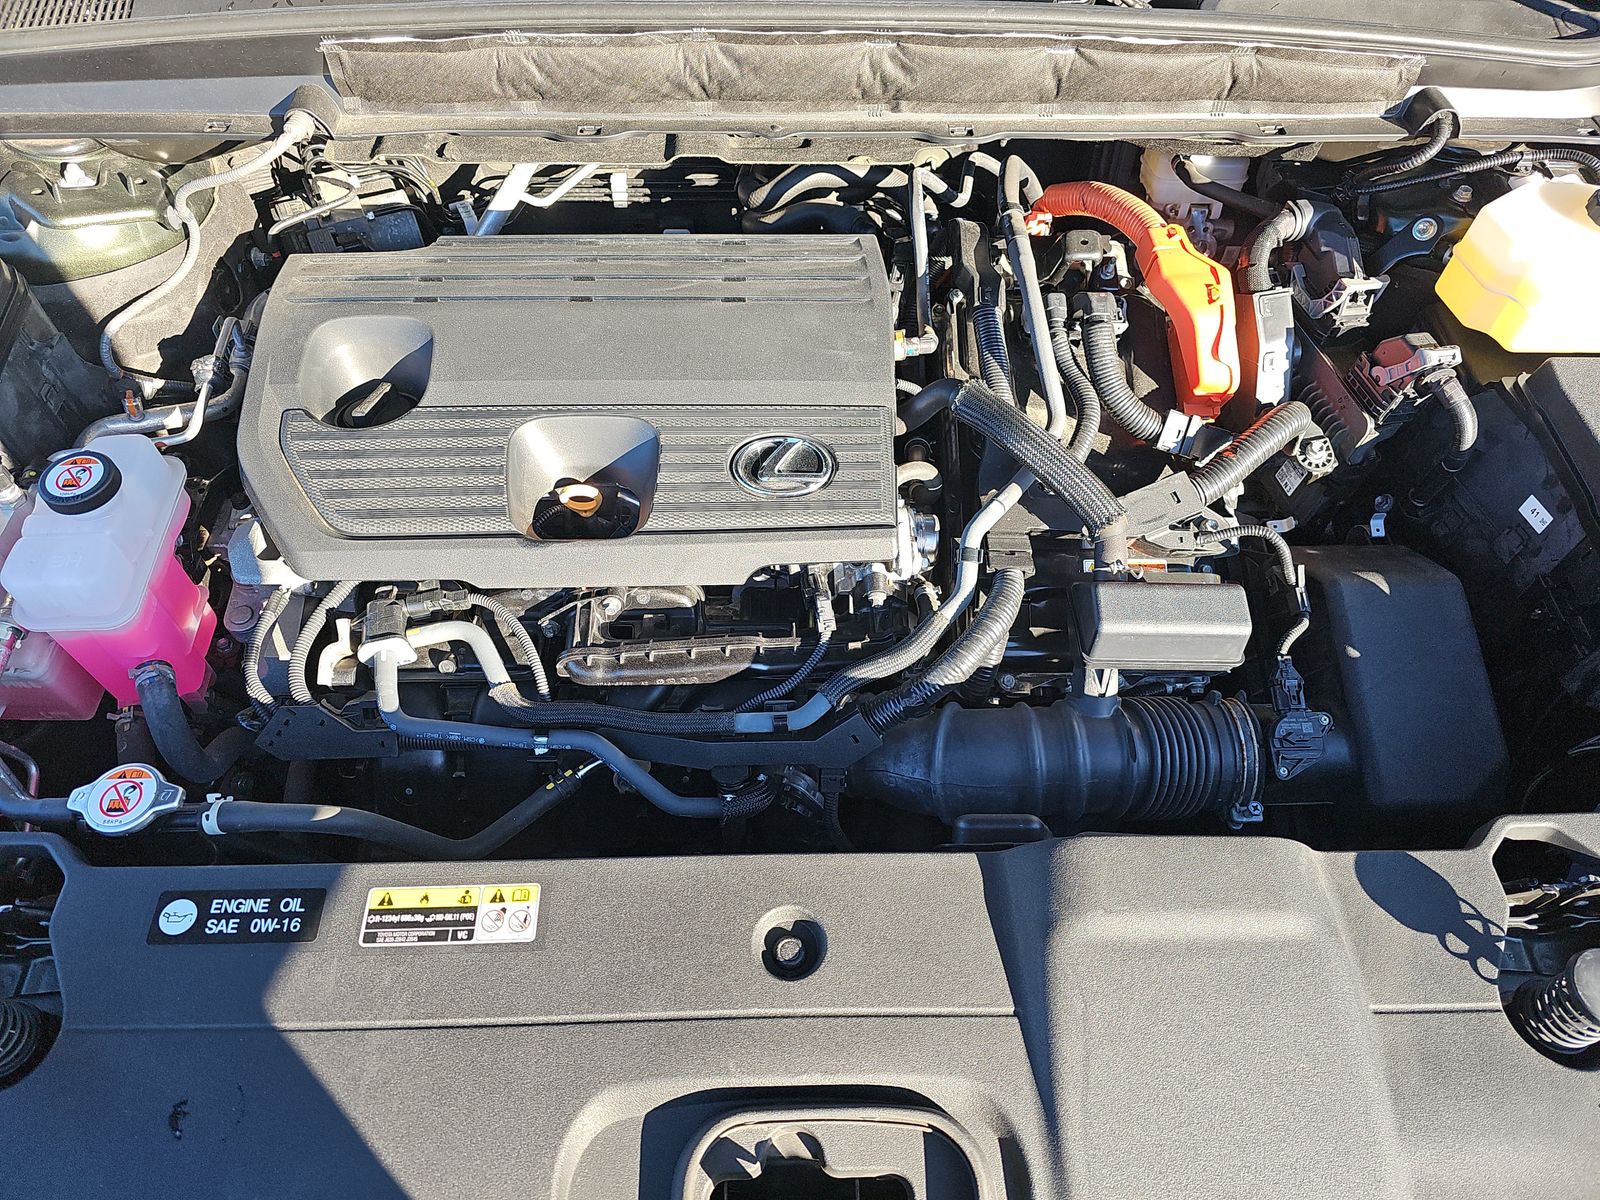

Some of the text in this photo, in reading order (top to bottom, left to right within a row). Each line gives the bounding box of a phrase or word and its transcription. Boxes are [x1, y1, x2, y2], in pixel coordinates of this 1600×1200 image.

[1530, 508, 1540, 518] 41
[210, 897, 305, 914] ENGINE OIL
[204, 917, 301, 934] SAE 0W-16
[457, 930, 468, 940] VC
